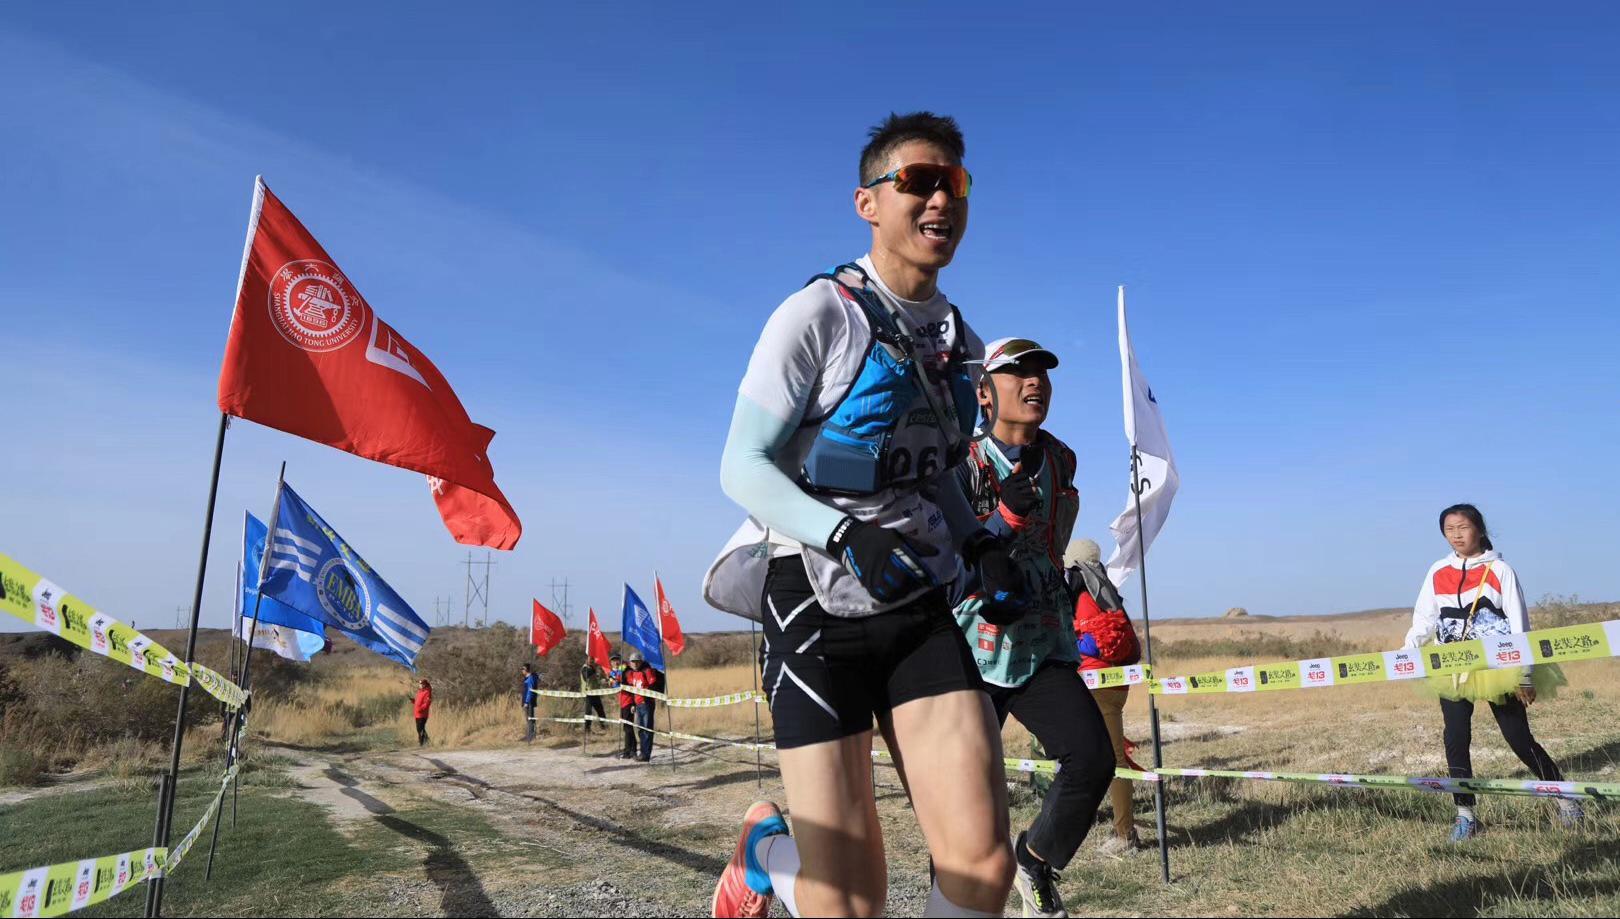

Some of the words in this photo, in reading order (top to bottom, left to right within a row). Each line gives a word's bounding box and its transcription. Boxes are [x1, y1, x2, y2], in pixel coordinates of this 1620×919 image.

[273, 291, 288, 330] SHANGHAI
[287, 328, 303, 342] JIAO
[304, 338, 325, 347] TONG
[326, 318, 359, 346] UNIVERSITY
[326, 572, 362, 620] EMBA
[1497, 641, 1513, 649] Jeep
